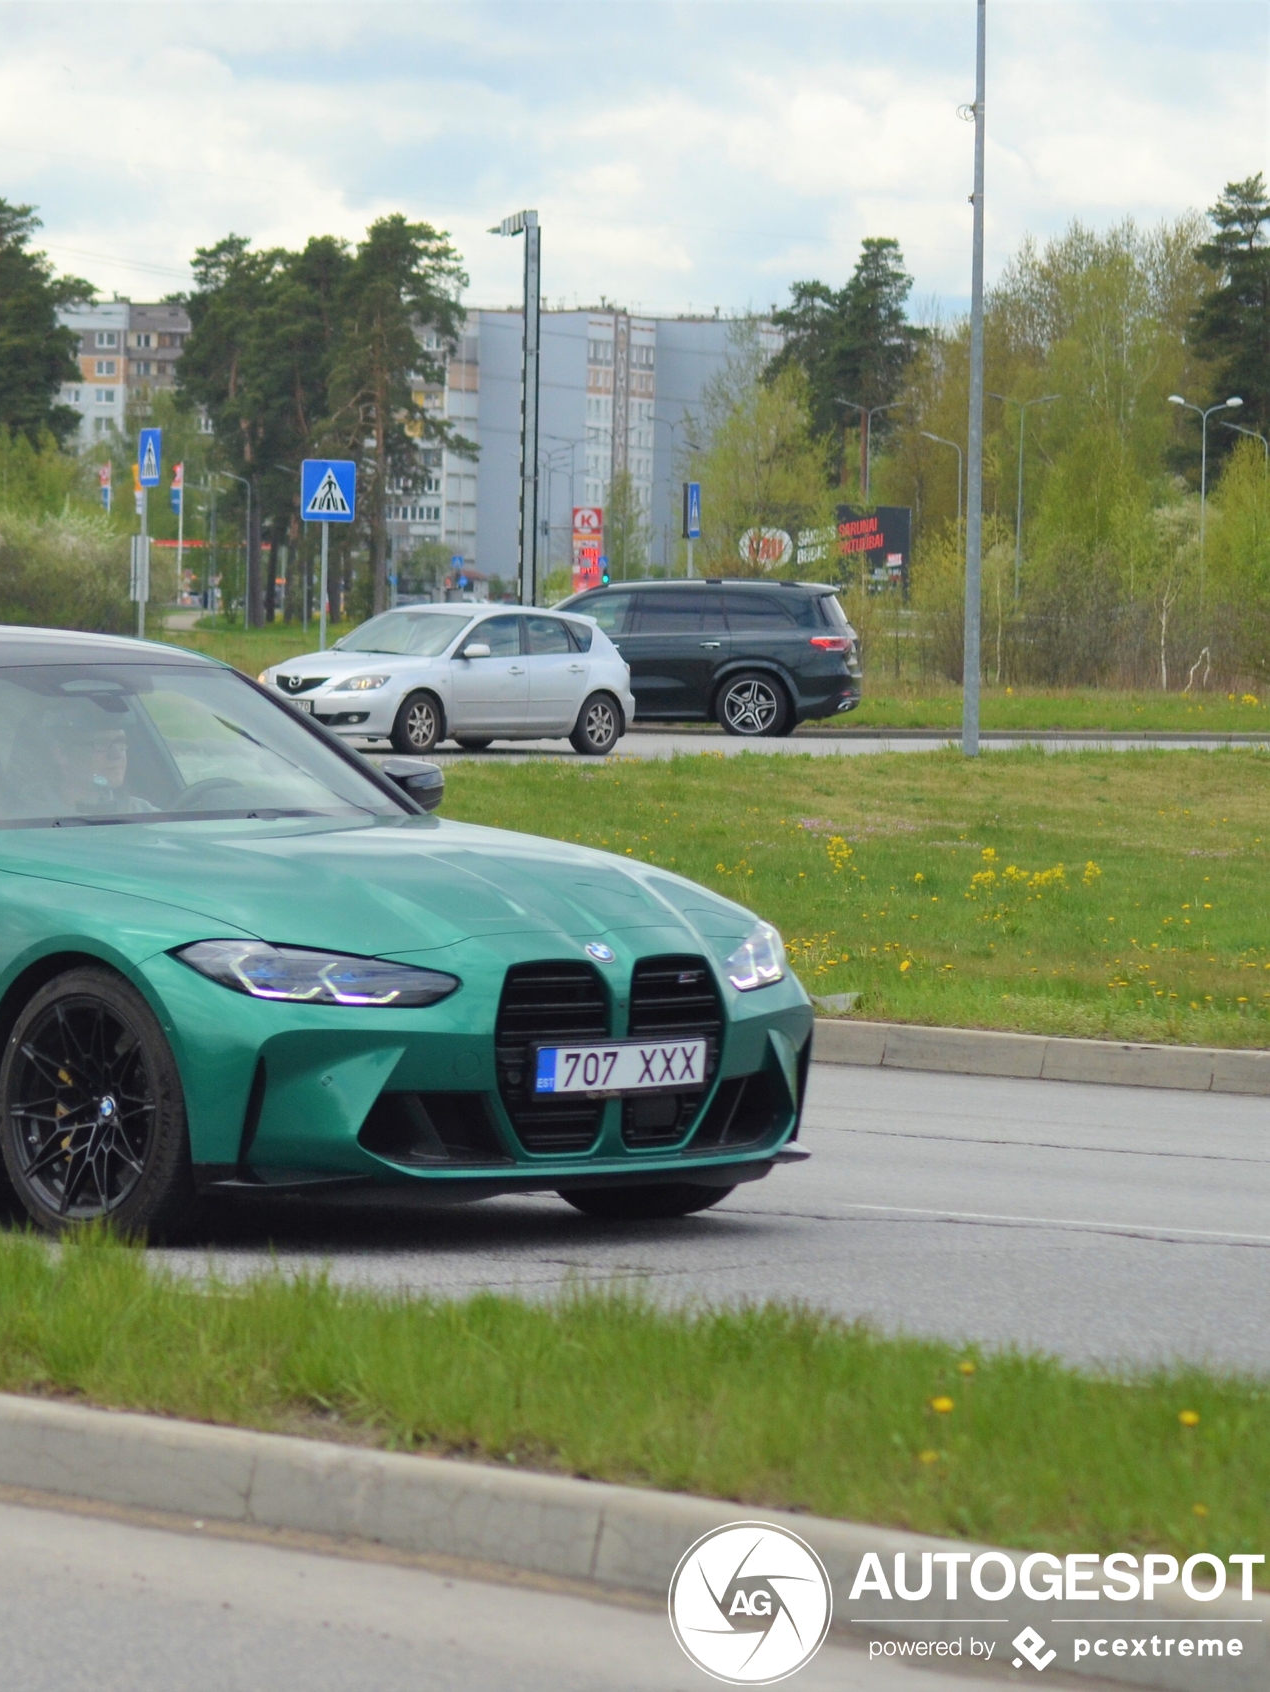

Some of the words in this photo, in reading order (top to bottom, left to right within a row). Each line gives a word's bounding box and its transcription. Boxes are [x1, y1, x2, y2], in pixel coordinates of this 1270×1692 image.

[581, 514, 592, 527] K
[838, 517, 879, 537] SARUNAI
[563, 1050, 619, 1088] 707
[637, 1045, 698, 1084] XXX
[536, 1078, 555, 1088] EST
